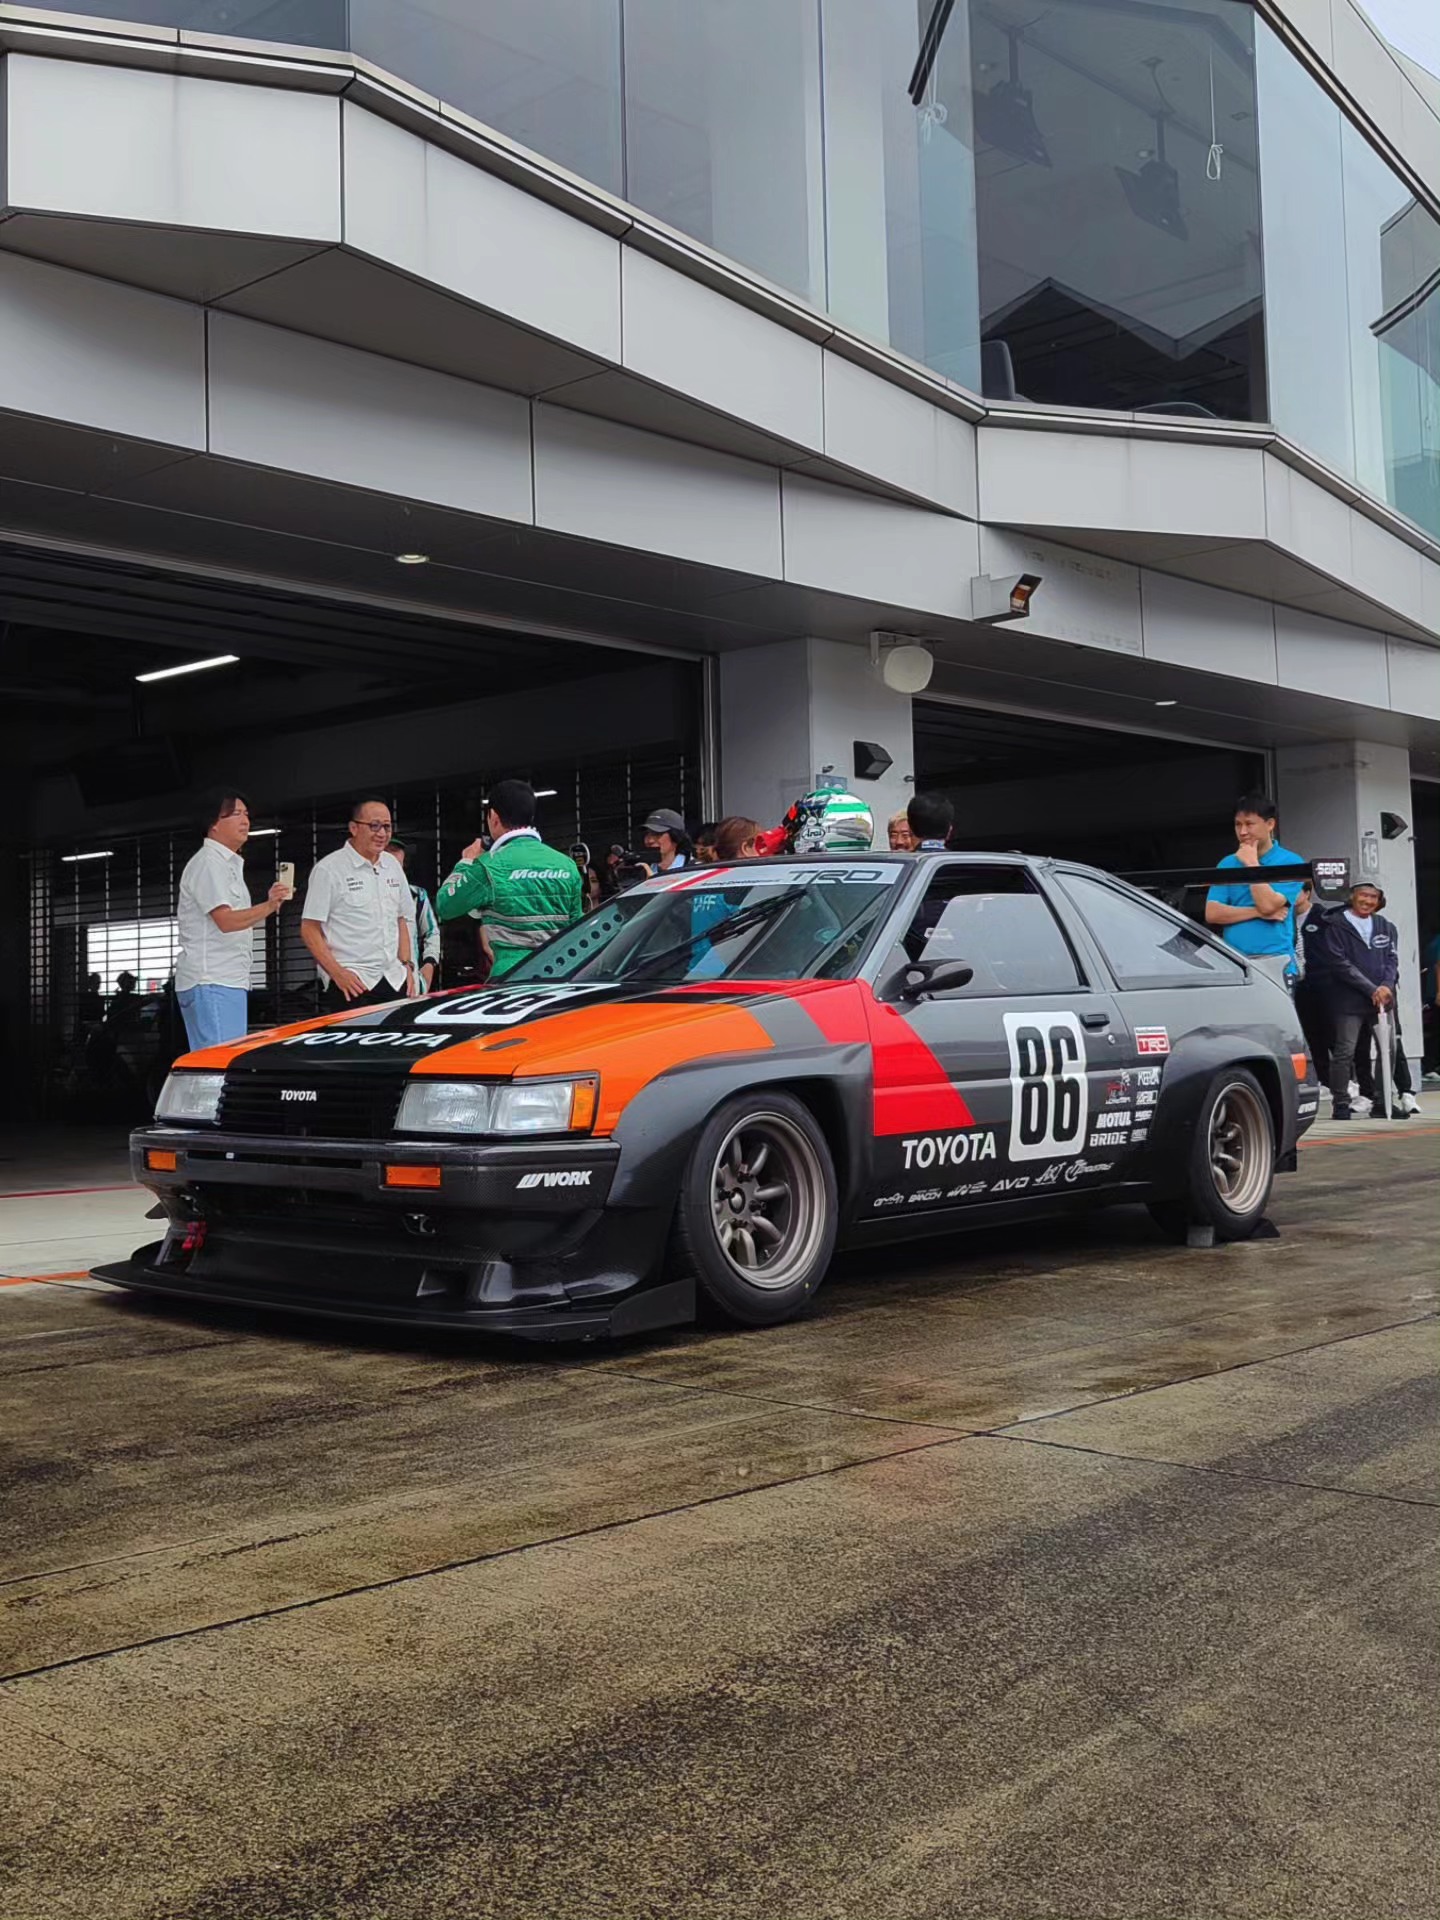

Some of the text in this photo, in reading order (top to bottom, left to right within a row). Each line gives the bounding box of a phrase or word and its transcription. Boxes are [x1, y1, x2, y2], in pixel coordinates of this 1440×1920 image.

[1364, 843, 1378, 869] 15
[788, 870, 884, 885] TRD
[283, 1032, 452, 1047] TOYOTA
[1016, 1026, 1081, 1145] 86
[280, 1090, 317, 1102] TOYOTA
[1095, 1111, 1132, 1129] MOTUL
[1089, 1131, 1128, 1147] BRIDE
[902, 1131, 997, 1169] TOYOTA
[543, 1170, 592, 1187] WORK
